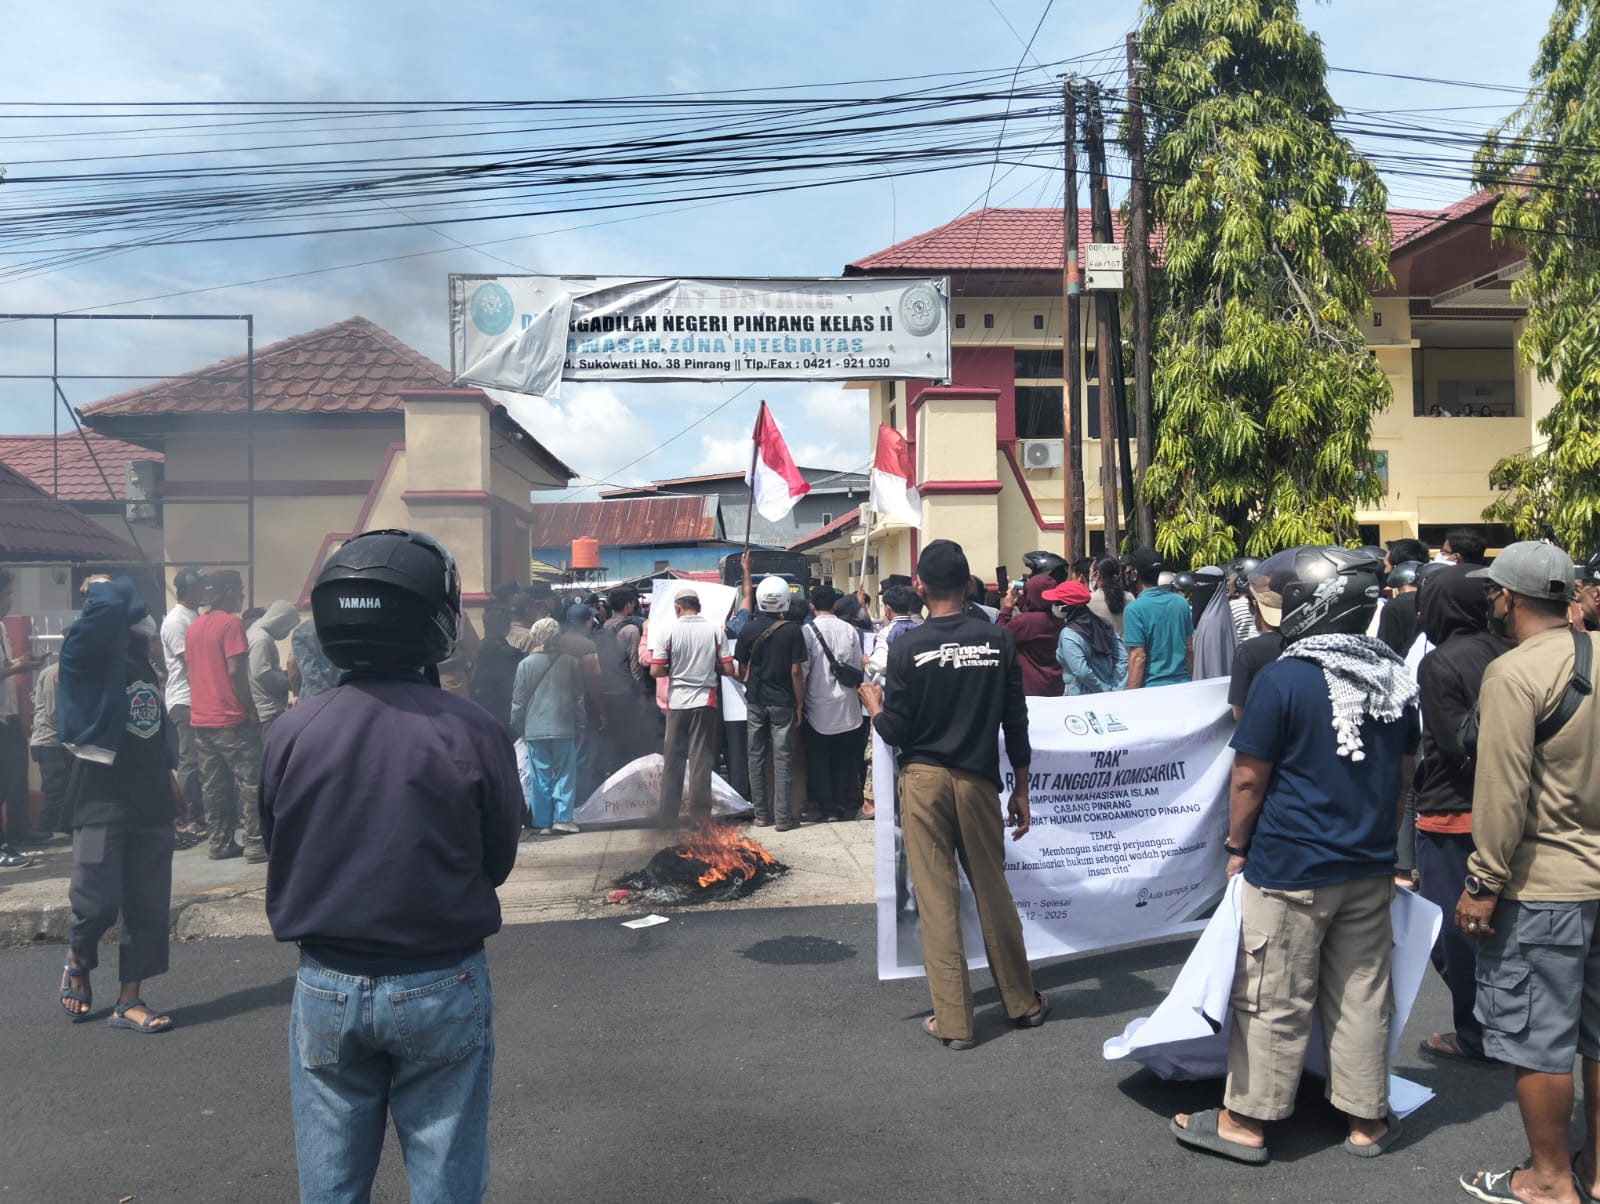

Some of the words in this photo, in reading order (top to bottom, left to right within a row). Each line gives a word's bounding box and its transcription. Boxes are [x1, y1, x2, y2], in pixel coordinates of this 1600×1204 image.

[662, 315, 727, 331] NEGERI
[733, 315, 815, 331] PINRANG
[820, 315, 874, 331] KELAS
[880, 315, 893, 331] II
[670, 337, 726, 353] ZONA
[734, 337, 864, 353] INTEGRITAS
[580, 358, 637, 369] Sukowati
[641, 359, 662, 369] No.
[666, 359, 680, 369] 38
[685, 358, 731, 371] Pinrang
[803, 359, 831, 369] 0421
[843, 358, 864, 369] 921
[869, 358, 890, 369] 030
[338, 597, 382, 609] YAMAHA
[1090, 749, 1129, 769] "RAK"
[1051, 771, 1113, 790] ANGGOTA
[1112, 761, 1186, 787] KOMISARIAT
[1074, 789, 1130, 801] MAHASISWA
[1130, 787, 1160, 797] ISLAM
[1053, 803, 1090, 813] CABANG
[1092, 799, 1132, 811] PINRANG
[1050, 814, 1082, 825] HUKUM
[1083, 808, 1157, 823] COKROAMINOTO
[1158, 803, 1201, 815] PINRANG
[1089, 830, 1116, 841] TEMA:
[1092, 841, 1120, 853] sinergi
[1122, 837, 1176, 852] perjuangan:
[1022, 859, 1066, 870] komisariat
[1067, 857, 1094, 867] hukum
[1095, 853, 1129, 865] sebagai
[1129, 849, 1160, 861] wadah
[1087, 866, 1112, 877] insan
[1039, 897, 1072, 908] Selesai
[1026, 911, 1036, 920] 12
[1044, 910, 1068, 920] 2025
